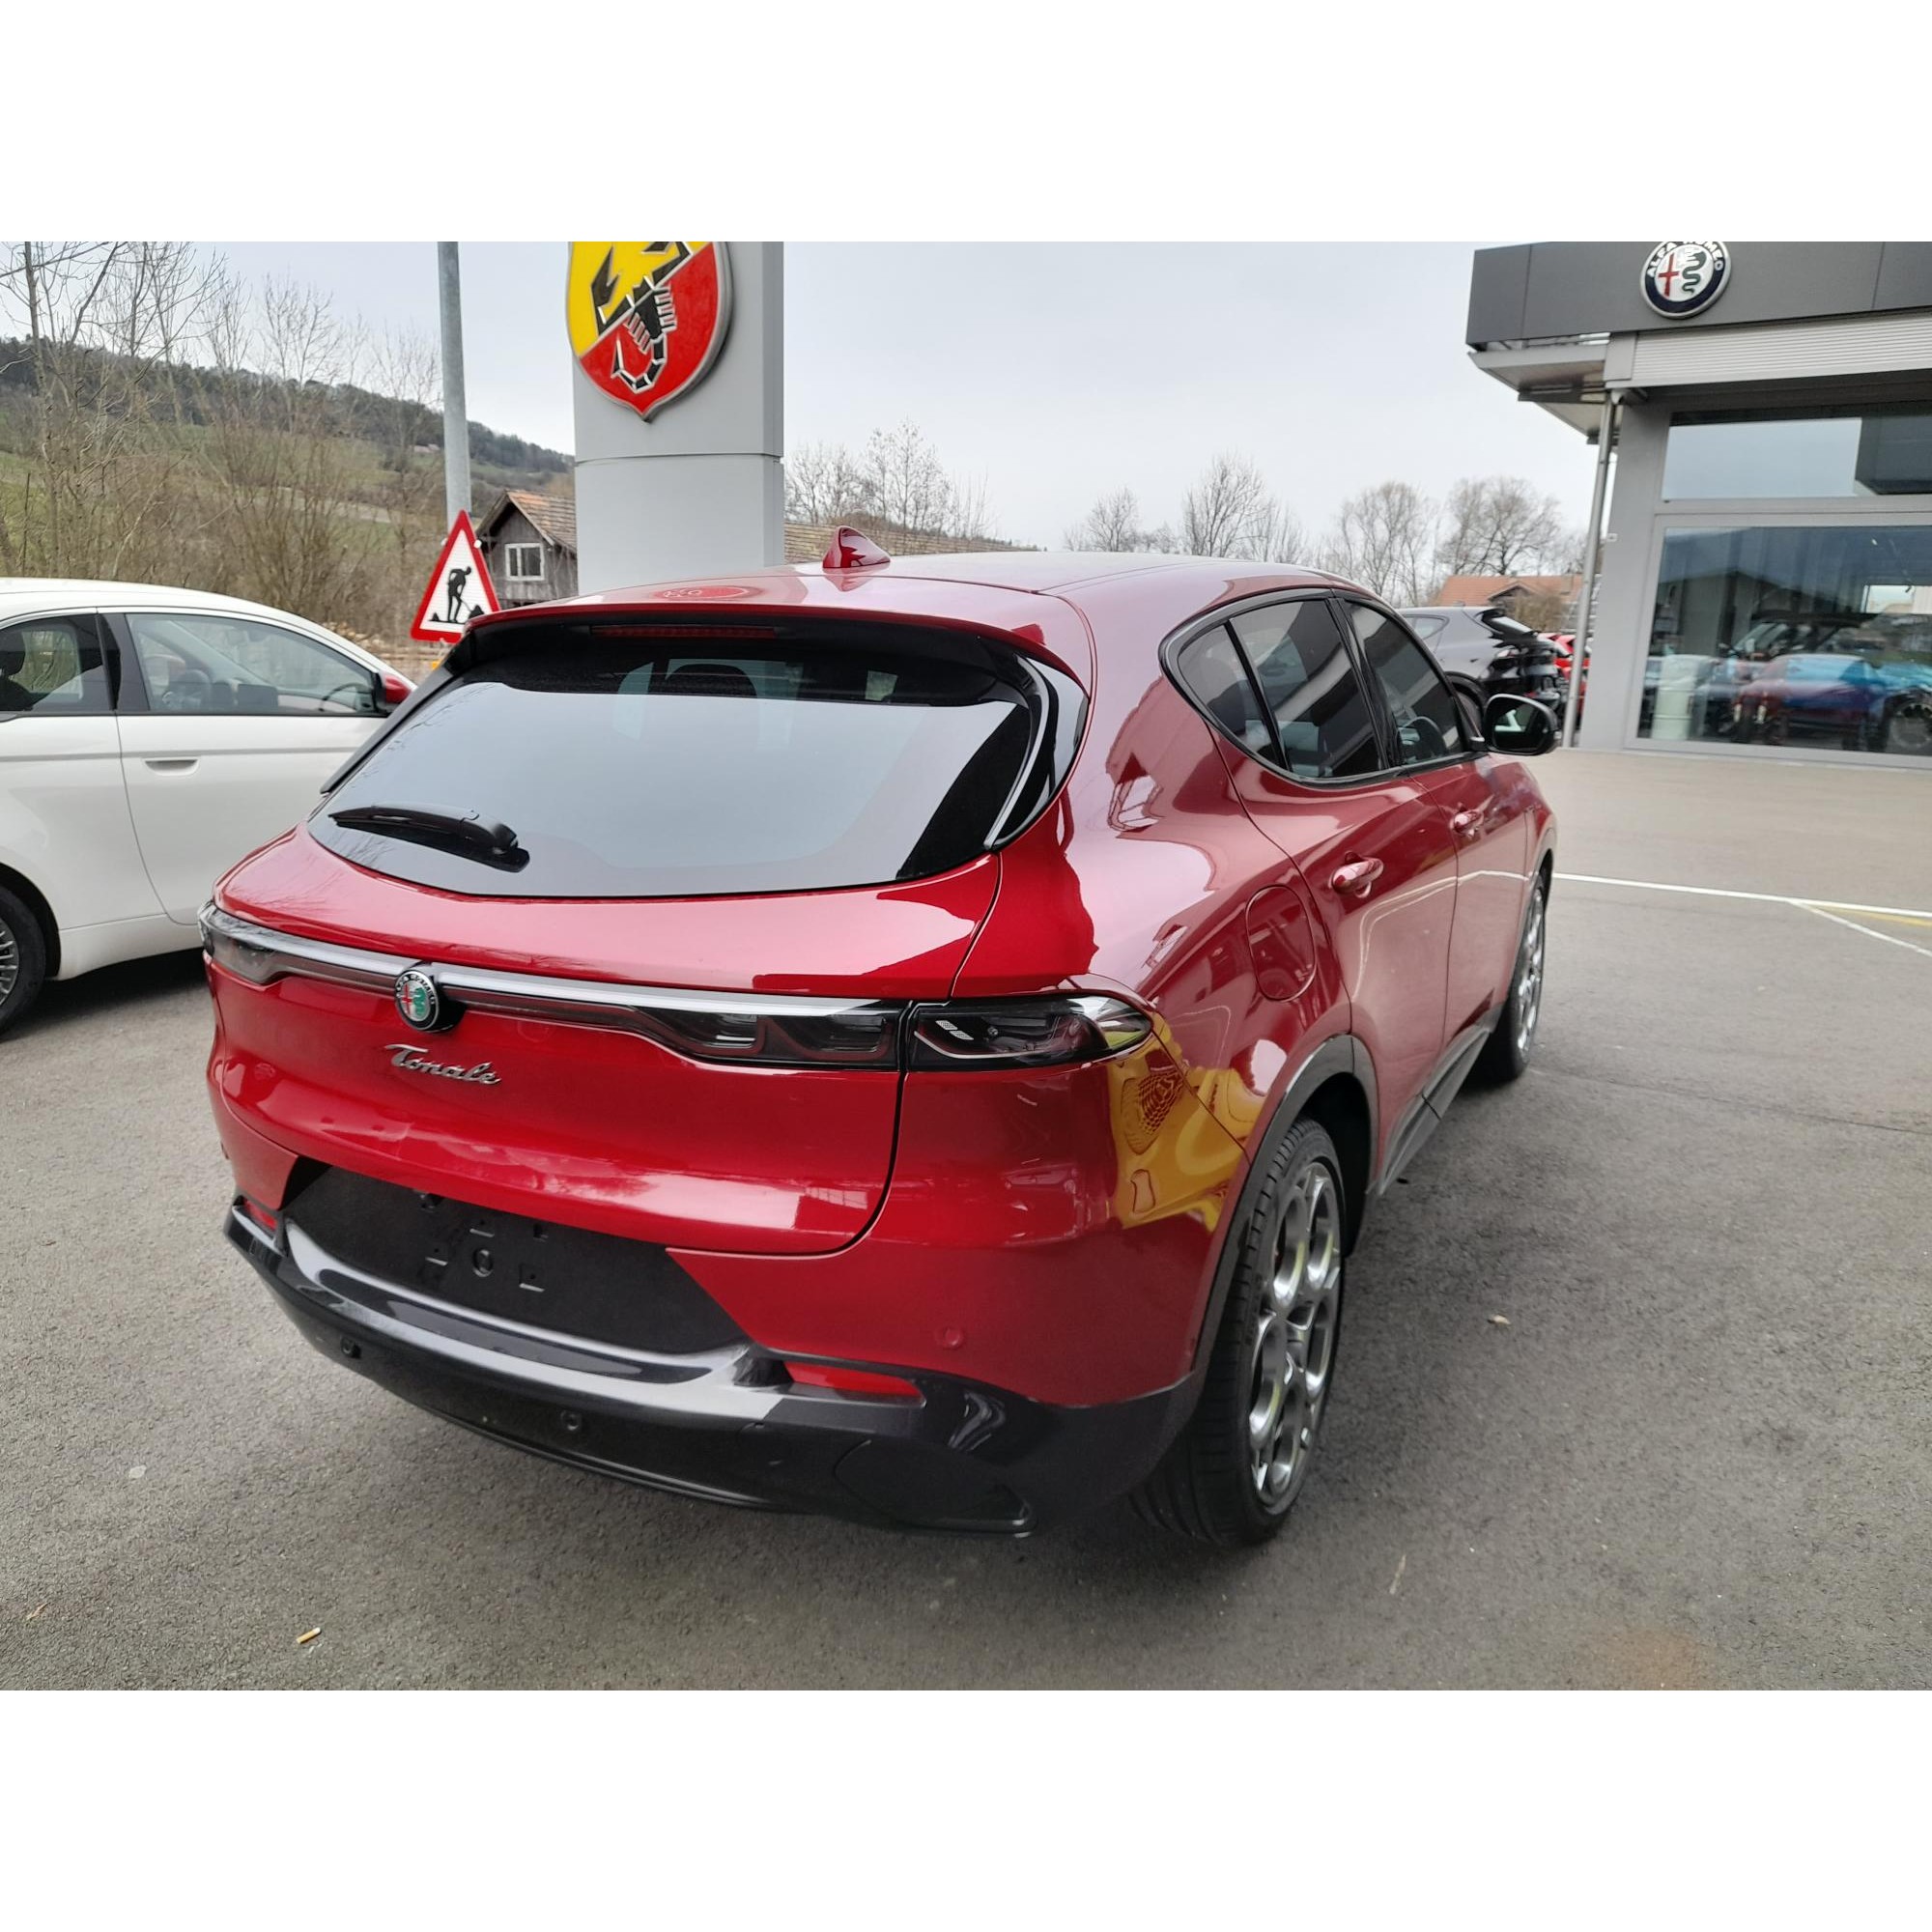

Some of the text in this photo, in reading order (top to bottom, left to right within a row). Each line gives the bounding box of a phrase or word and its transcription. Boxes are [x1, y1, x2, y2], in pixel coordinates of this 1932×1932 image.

[1647, 242, 1724, 277] ALFA MEO
[384, 1043, 501, 1084] Tonale
